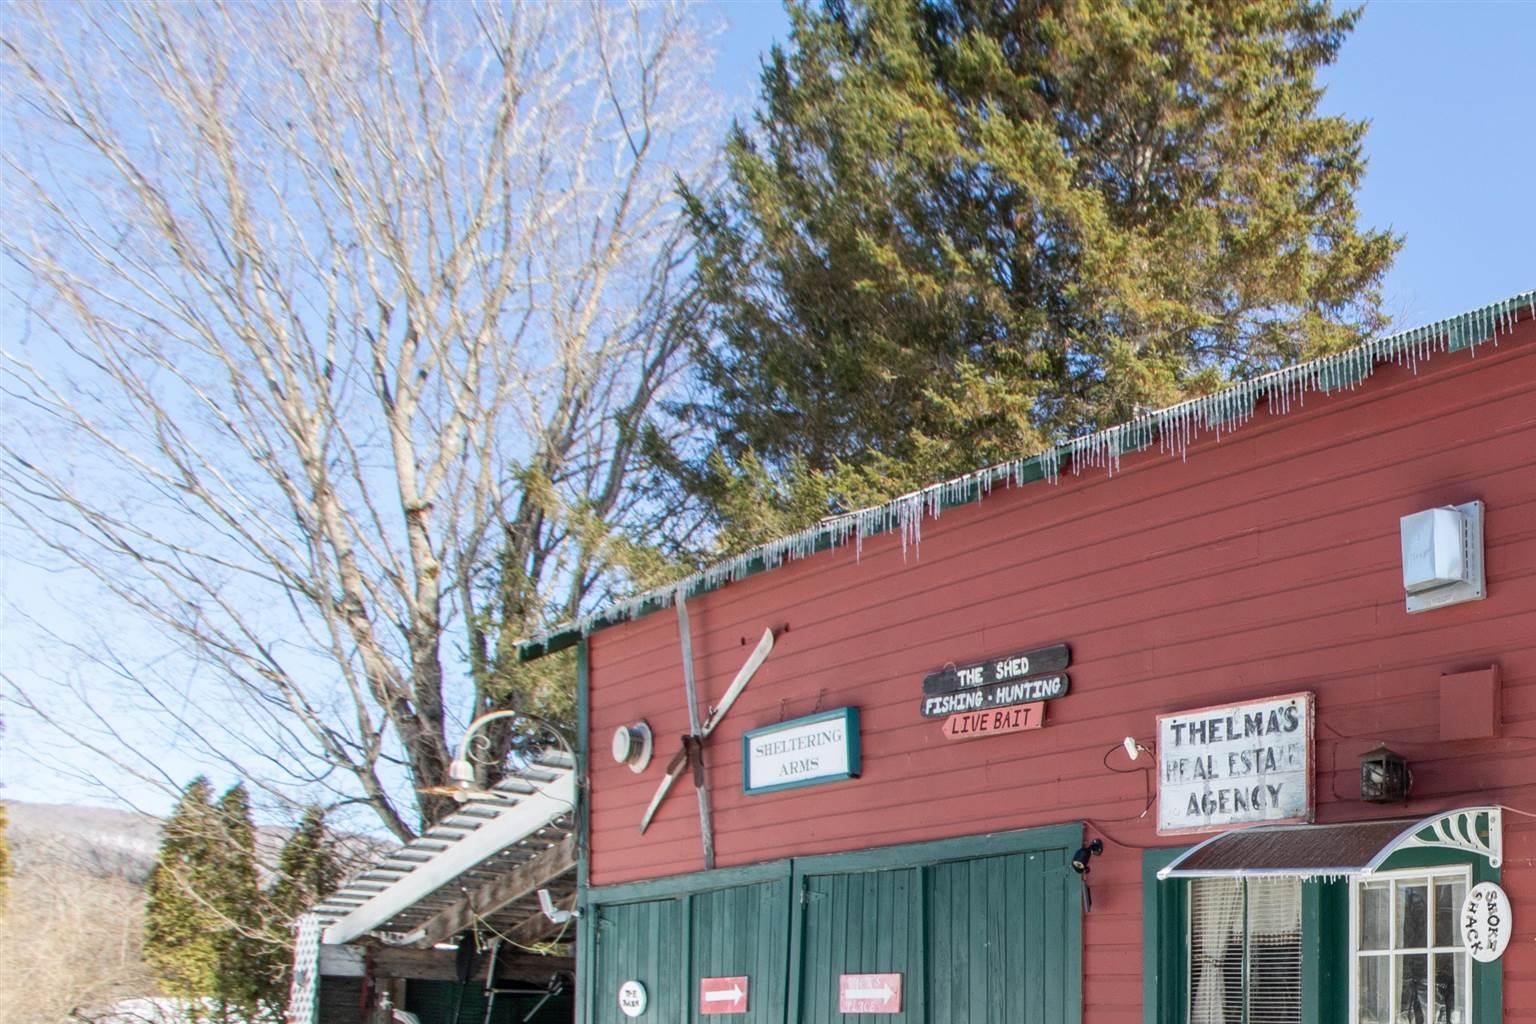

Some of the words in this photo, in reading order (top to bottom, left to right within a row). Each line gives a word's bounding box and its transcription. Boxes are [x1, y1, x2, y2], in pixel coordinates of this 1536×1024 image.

[957, 667, 983, 687] THE
[995, 657, 1029, 680] SHED
[925, 691, 984, 715] FISHING
[995, 677, 1061, 705] HUNTING
[951, 713, 992, 734] LIVE
[993, 708, 1032, 730] BAIT
[1170, 706, 1299, 746] THELMA'S
[756, 730, 842, 758] SHELTERING
[779, 758, 820, 776] ARMS
[1186, 782, 1284, 816] AGENCY
[1465, 889, 1483, 955] SHACK
[1485, 890, 1500, 952] SMOKE
